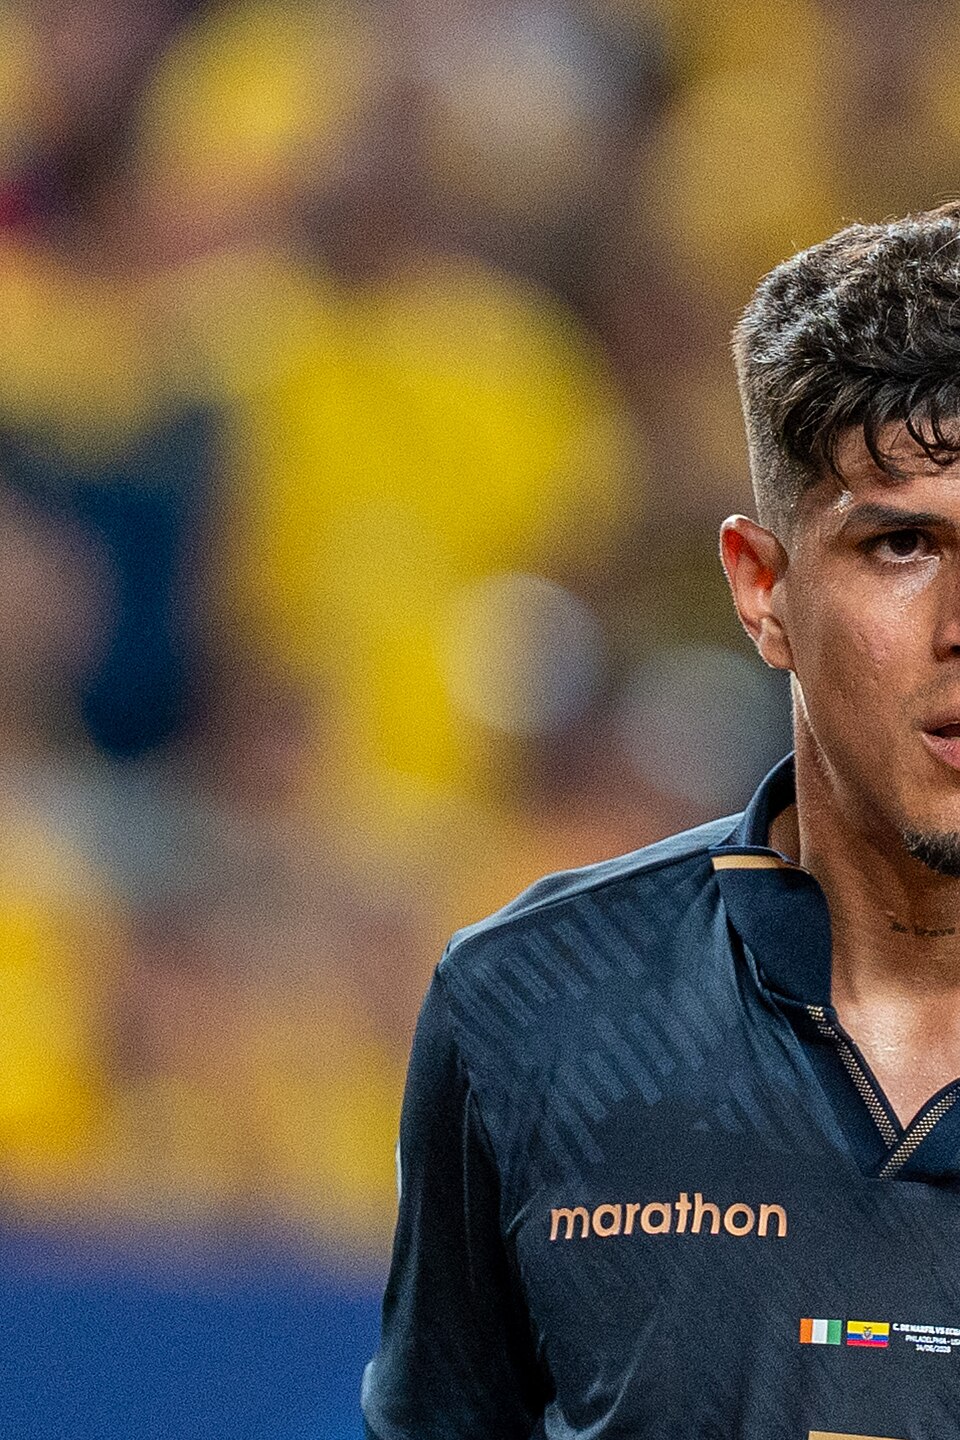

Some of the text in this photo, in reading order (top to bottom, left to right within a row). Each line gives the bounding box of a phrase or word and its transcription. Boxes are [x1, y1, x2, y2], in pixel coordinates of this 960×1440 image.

[549, 1192, 788, 1241] marathon
[935, 1326, 945, 1335] VS
[905, 1334, 947, 1344] PHILADELPHIA
